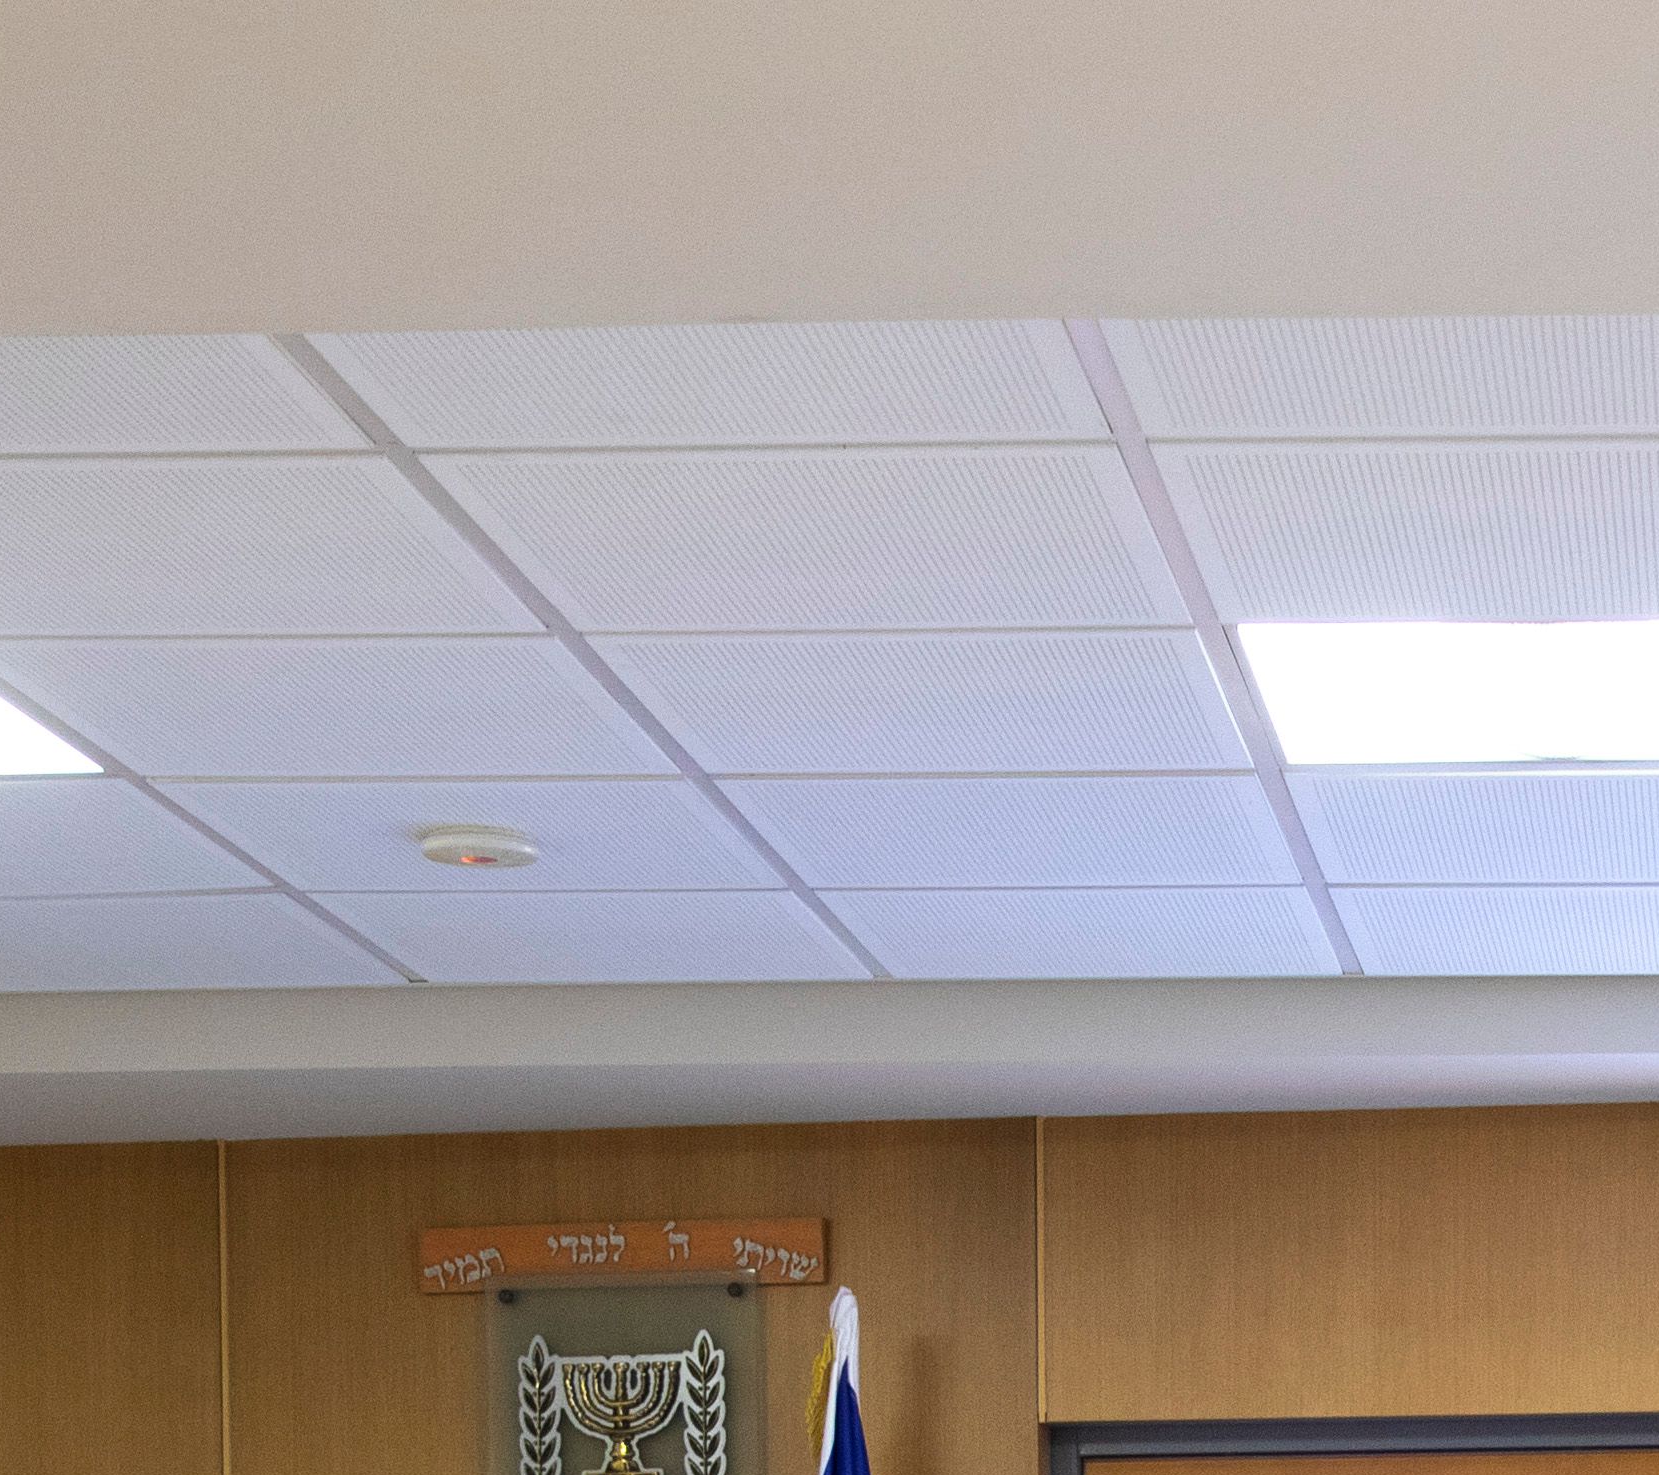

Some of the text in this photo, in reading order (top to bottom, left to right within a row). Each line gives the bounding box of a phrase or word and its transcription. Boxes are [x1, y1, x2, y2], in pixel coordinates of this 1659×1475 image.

[546, 1223, 627, 1264] לנגדי
[732, 1236, 819, 1281] שויתי
[422, 1245, 506, 1290] תמיד
